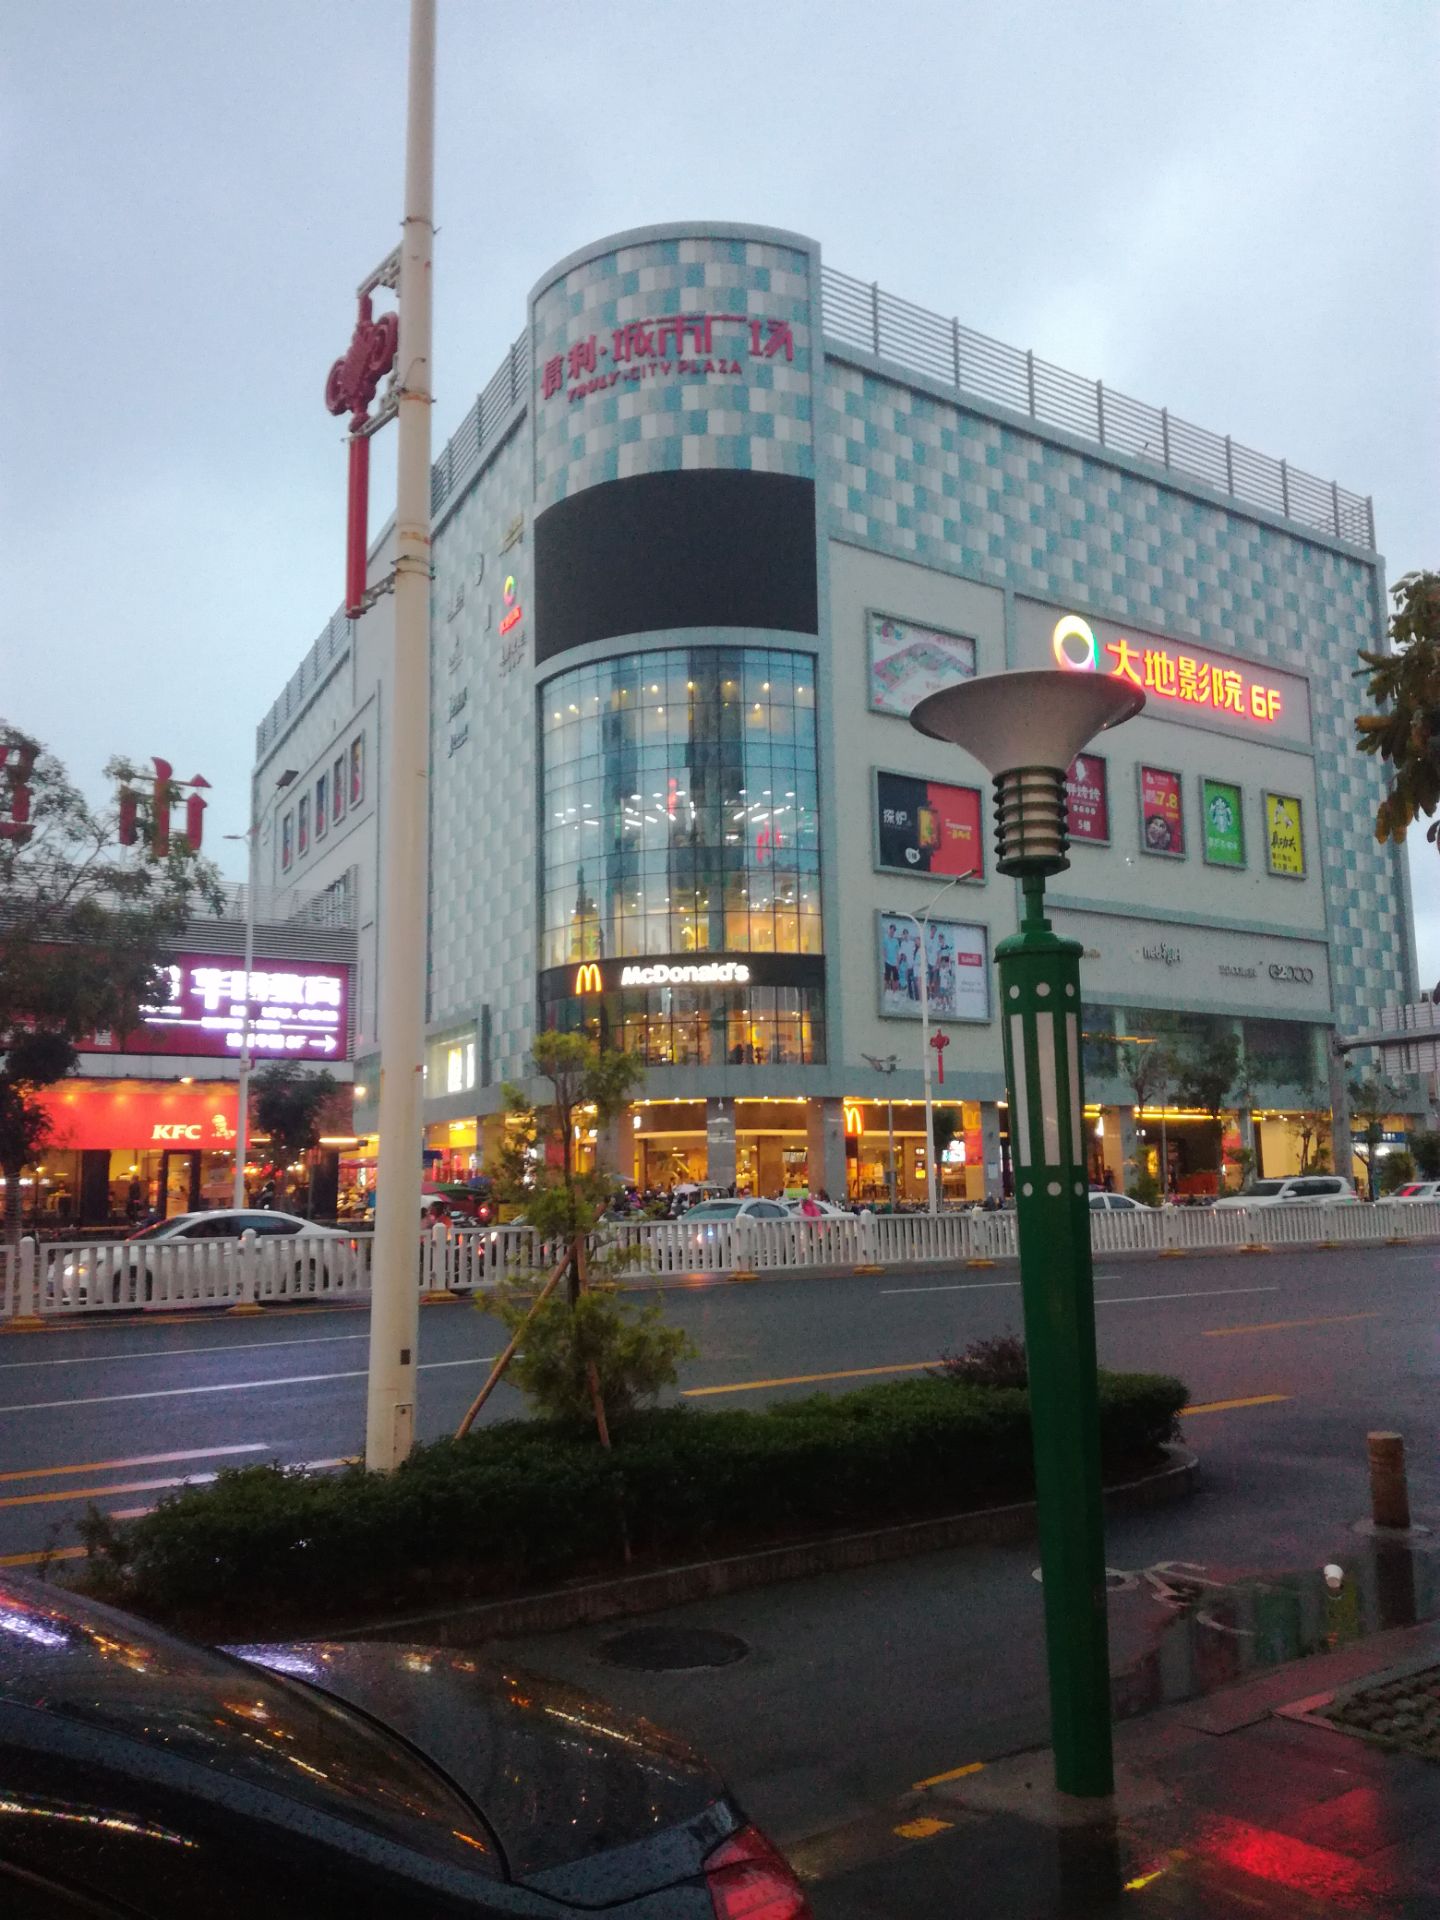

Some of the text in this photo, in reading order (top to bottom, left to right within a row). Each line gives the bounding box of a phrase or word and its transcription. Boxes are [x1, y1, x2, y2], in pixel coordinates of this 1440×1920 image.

[677, 358, 742, 375] PLAZA
[1106, 639, 1281, 721] 大地影院 6F
[620, 961, 750, 986] McDonald's
[151, 1124, 202, 1140] KFC
